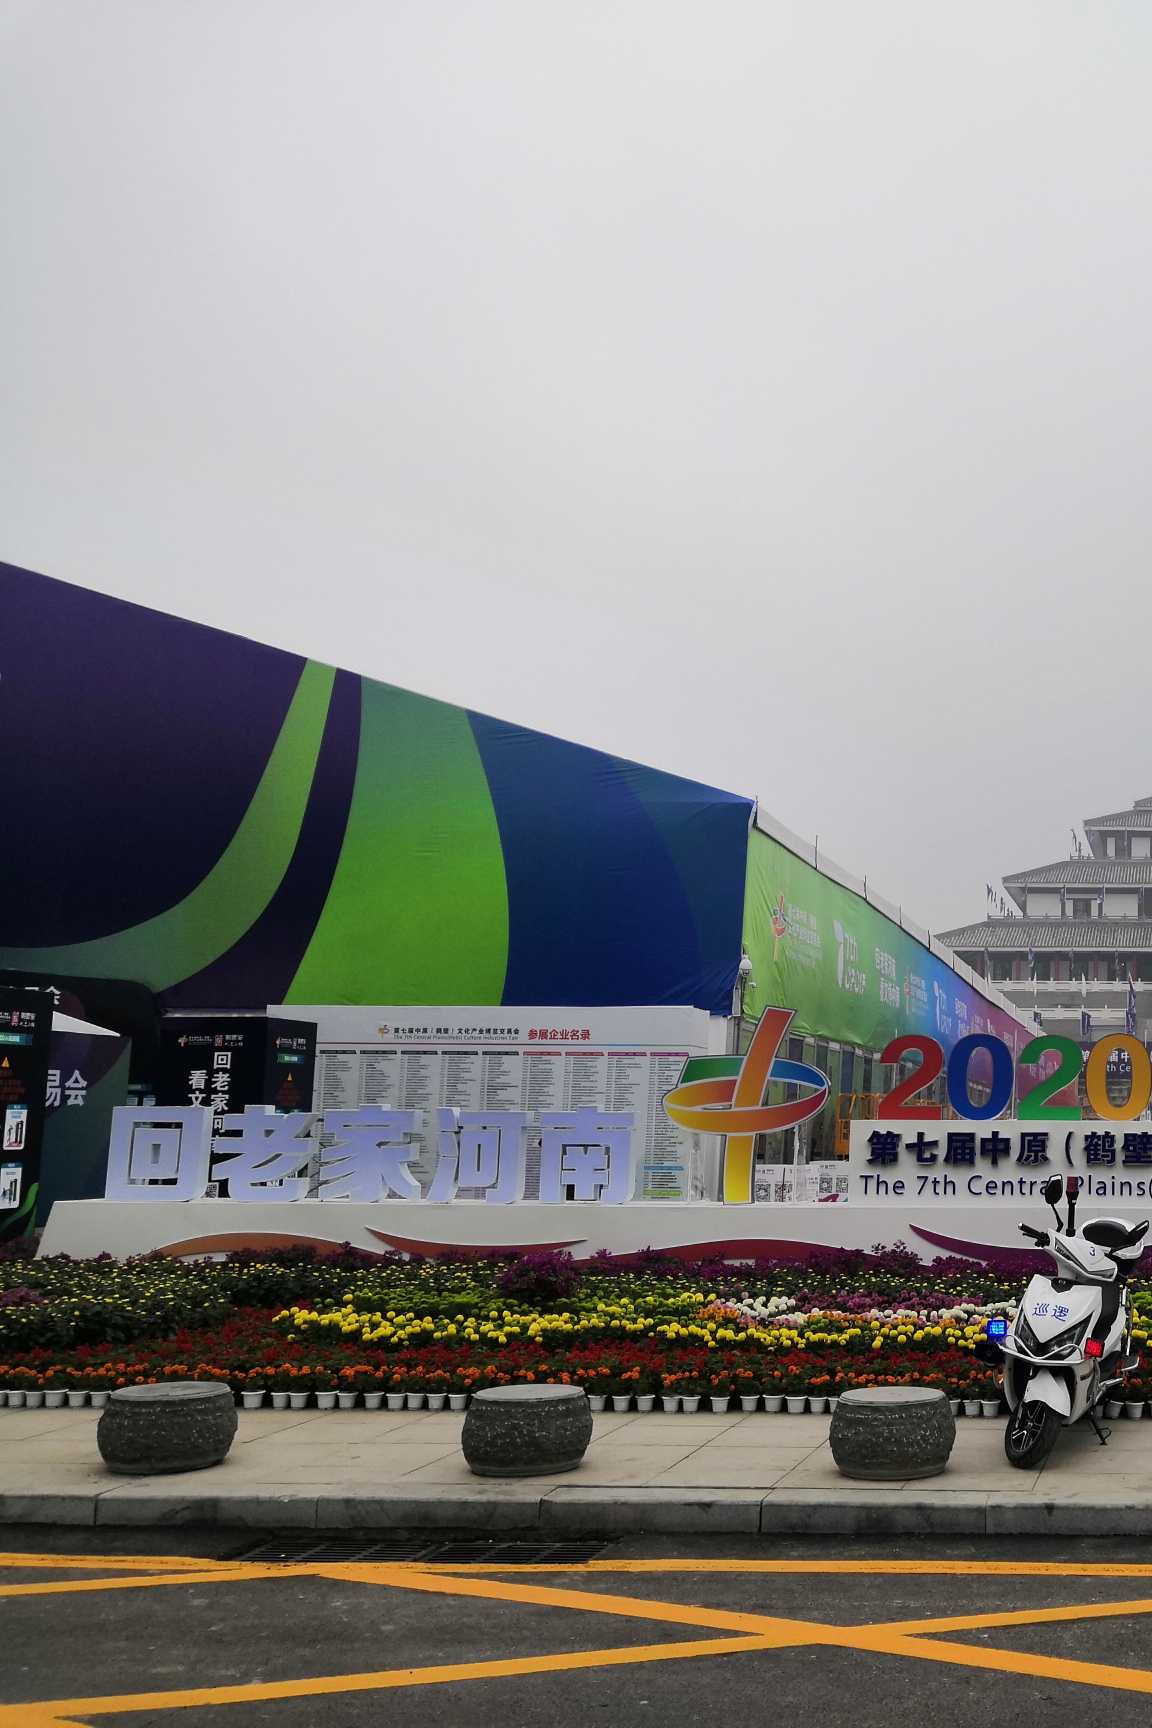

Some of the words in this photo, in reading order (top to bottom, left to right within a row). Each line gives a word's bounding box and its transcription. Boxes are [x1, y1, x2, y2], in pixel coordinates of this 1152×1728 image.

[528, 1029, 591, 1041] 参展企业名录
[878, 1033, 1152, 1121] 2020
[104, 1105, 641, 1203] 回老家河南
[860, 1174, 905, 1196] The
[916, 1174, 956, 1196] 7th
[967, 1174, 1051, 1197] Centra
[1089, 1247, 1096, 1257] 3
[1032, 1303, 1070, 1321] 巡逻
